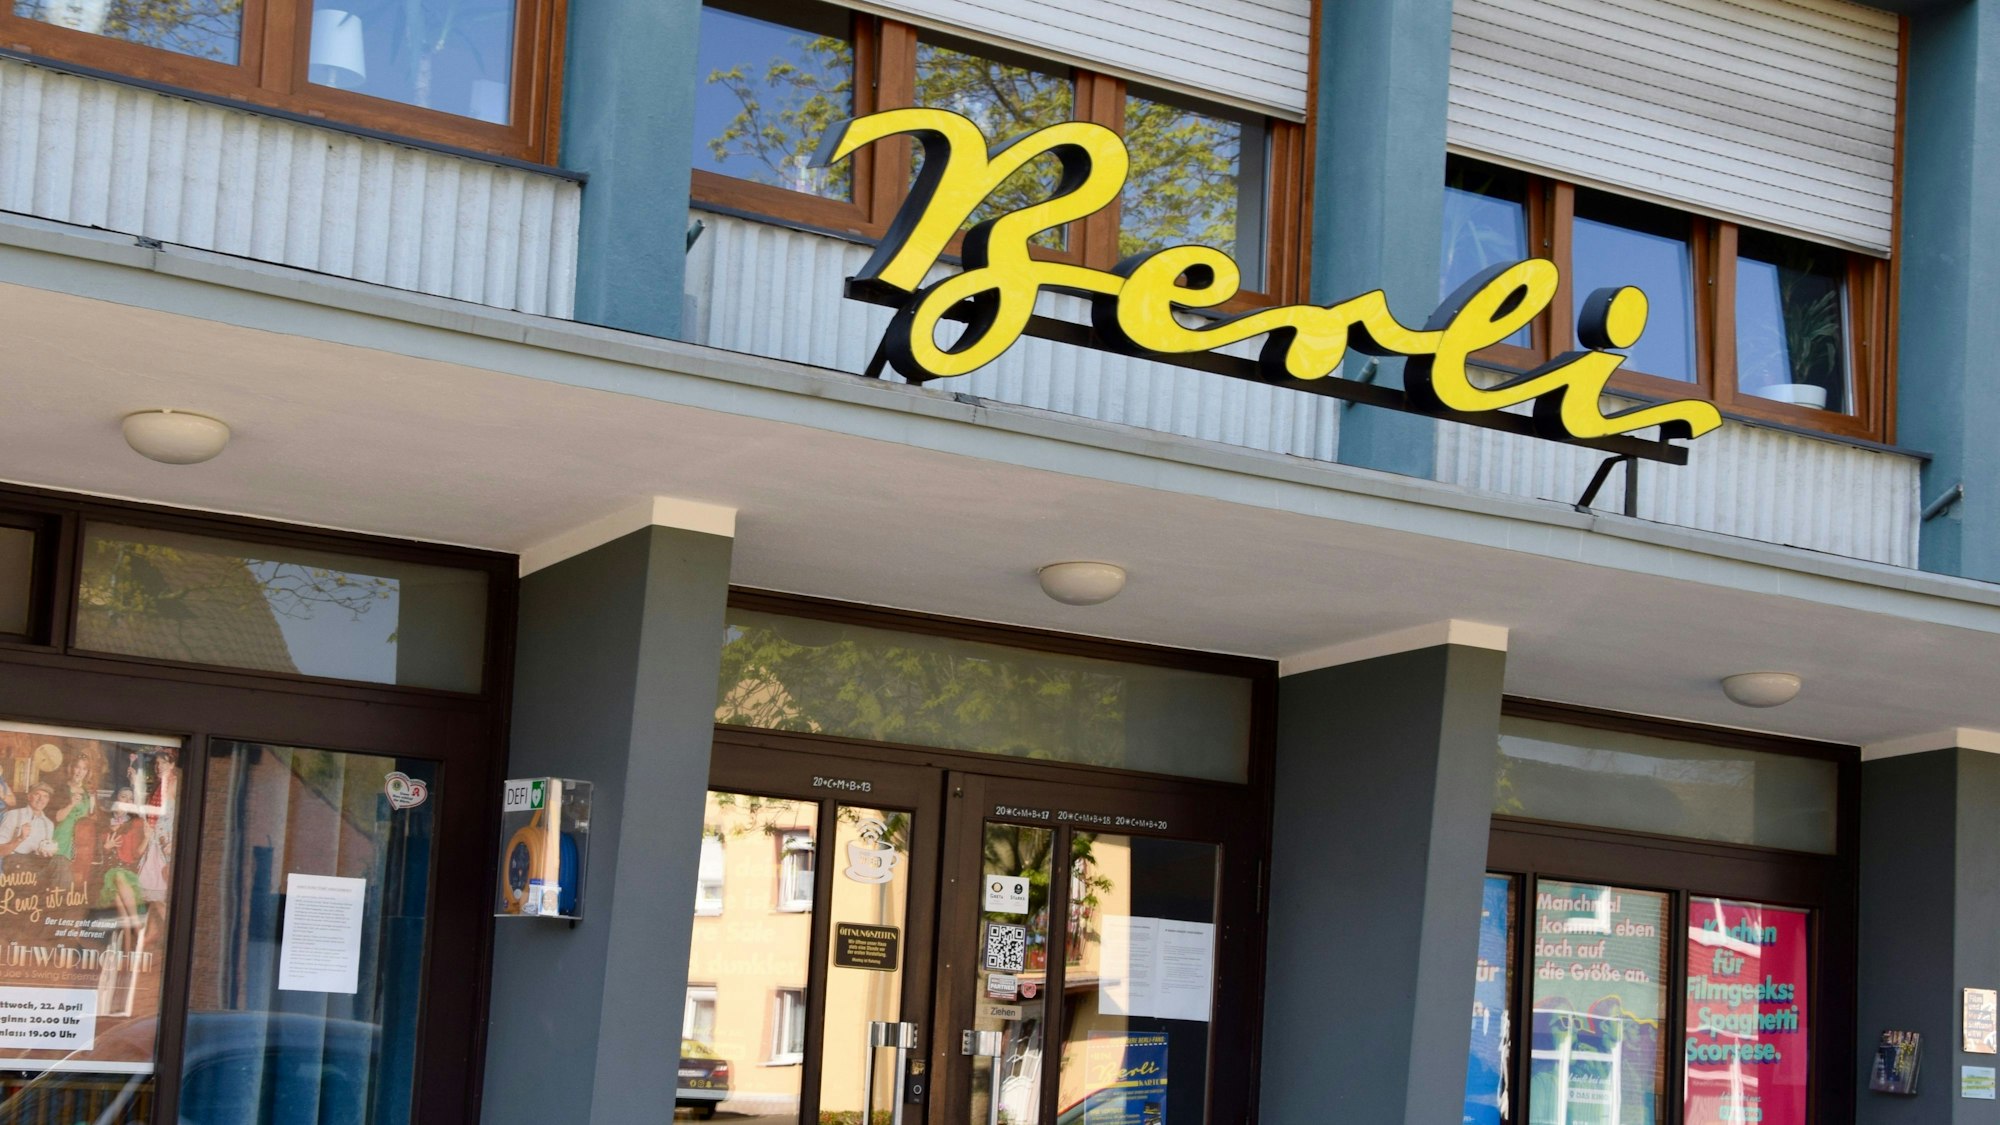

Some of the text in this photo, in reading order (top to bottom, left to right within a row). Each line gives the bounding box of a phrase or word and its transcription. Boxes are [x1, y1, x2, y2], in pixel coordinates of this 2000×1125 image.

[828, 106, 1723, 440] Berli
[506, 787, 528, 805] DEFI
[46, 887, 66, 909] ist
[66, 881, 88, 907] da!
[1536, 893, 1621, 913] Manchal
[44, 917, 117, 929] Der Lenz geht diesmal
[1615, 918, 1655, 937] eben
[55, 929, 105, 939] auf die Nerven!
[1535, 938, 1605, 958] doch auf
[1713, 948, 1745, 974] für
[32, 970, 59, 981] Swing
[1538, 960, 1649, 983] die Größe an.
[1687, 975, 1795, 1007] Filmgeeks:
[40, 1002, 55, 1010] 22.
[58, 1003, 83, 1012] April
[991, 1006, 1016, 1017] Ziehen
[0, 1015, 80, 1025] ginn: 20.00 Uhr
[1698, 1005, 1798, 1037] Spaghetti
[29, 1030, 56, 1038] 19.00
[59, 1031, 76, 1039] Uhr
